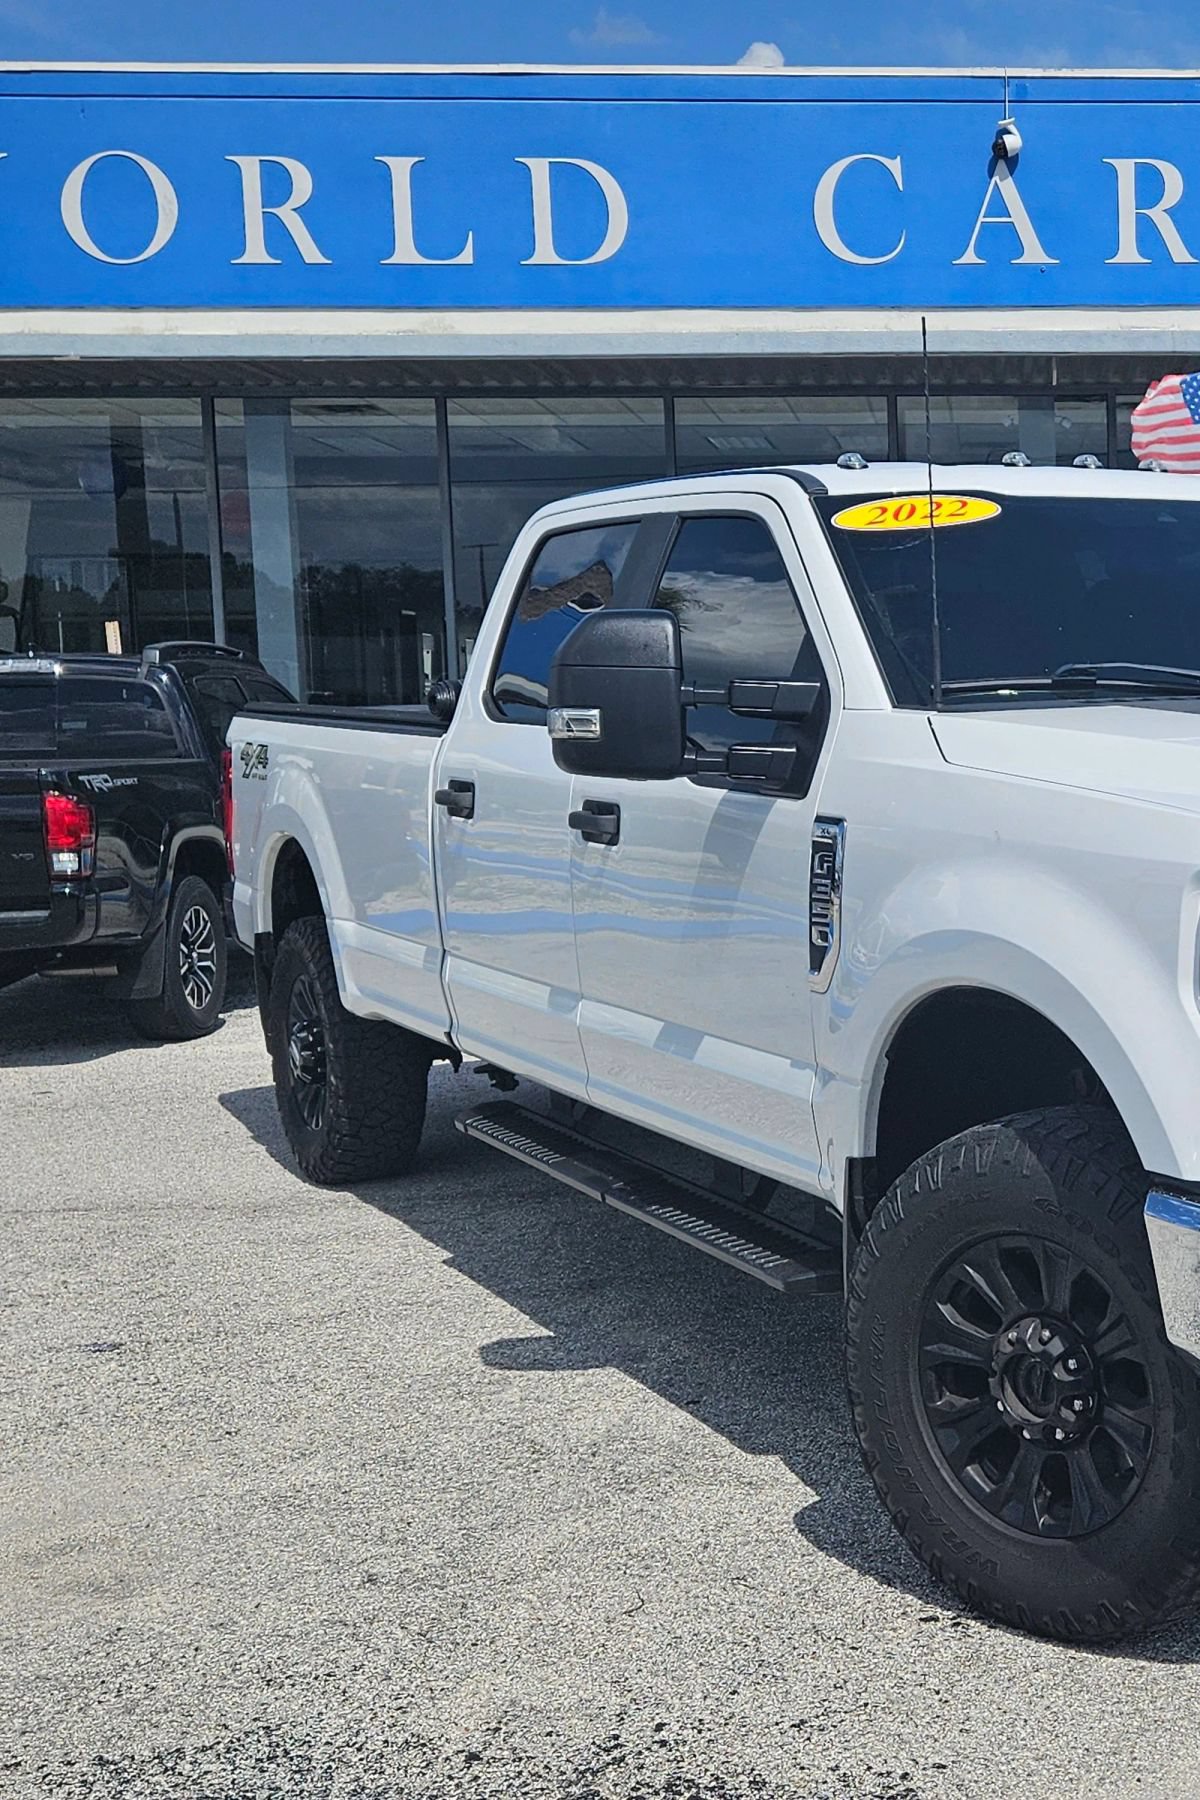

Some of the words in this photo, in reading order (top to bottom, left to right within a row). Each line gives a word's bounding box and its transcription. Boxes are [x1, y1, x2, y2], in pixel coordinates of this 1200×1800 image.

[0, 150, 629, 266] ORLD
[812, 153, 1200, 266] CAR
[864, 499, 968, 526] 2022
[78, 774, 113, 793] TRD
[820, 827, 831, 835] XL
